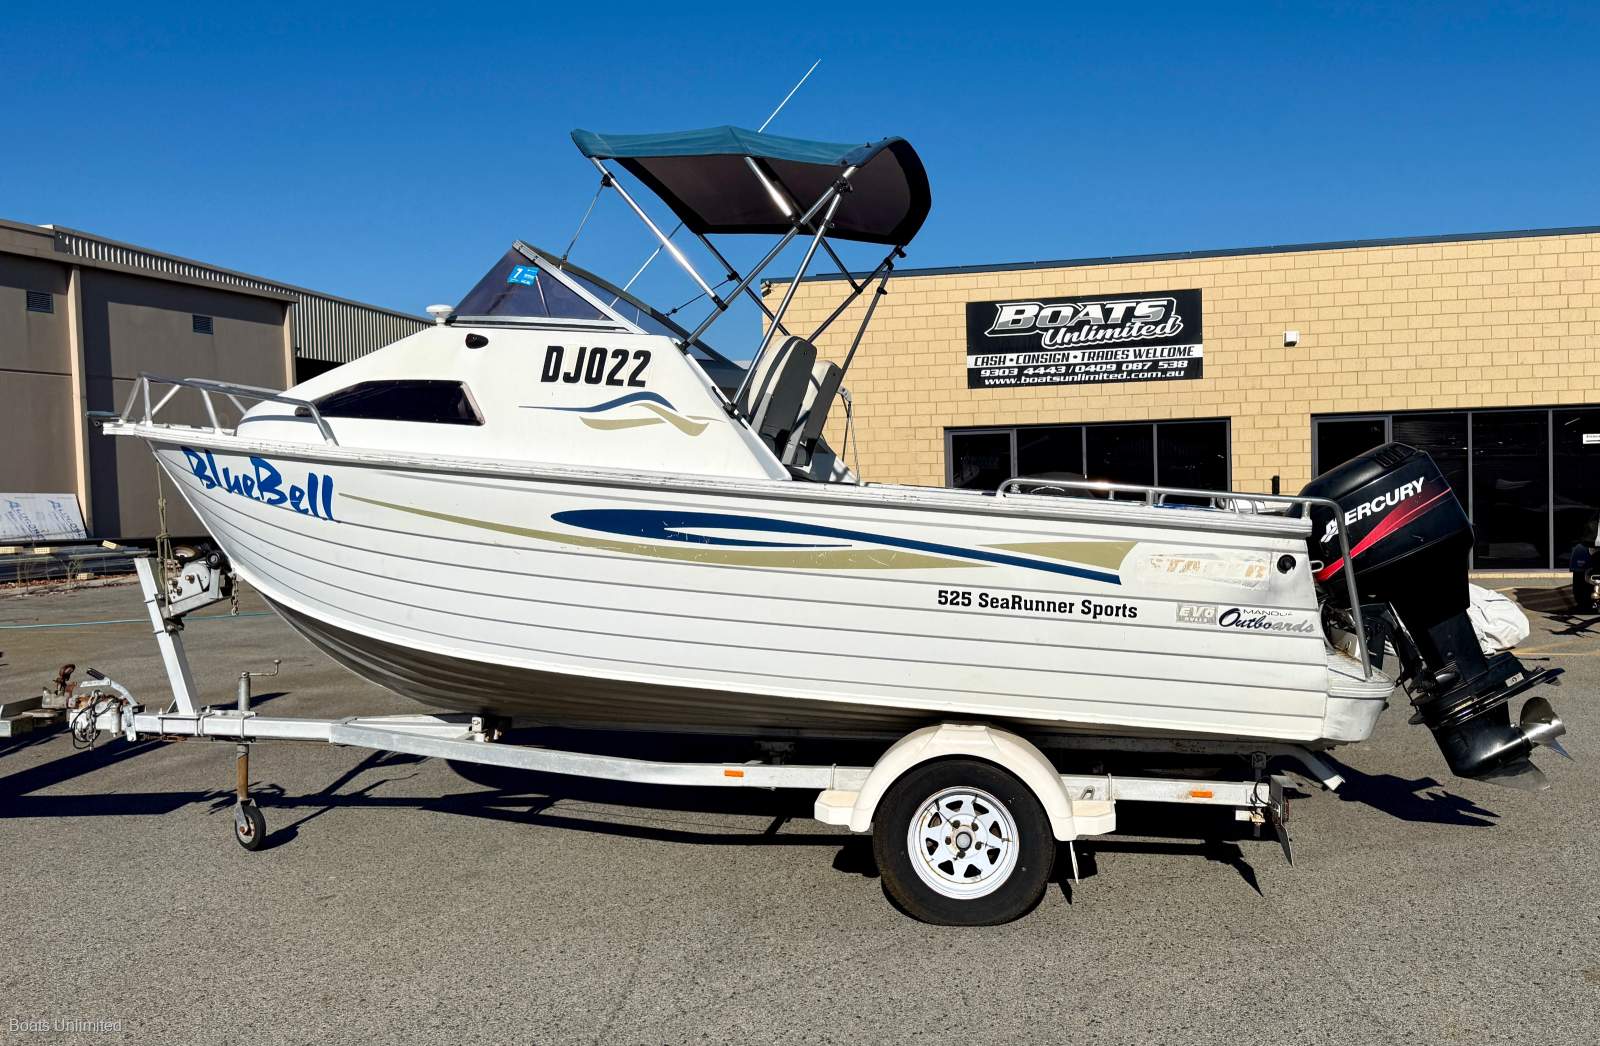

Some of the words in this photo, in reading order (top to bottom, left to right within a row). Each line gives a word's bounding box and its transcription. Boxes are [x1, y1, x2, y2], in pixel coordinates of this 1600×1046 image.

[993, 300, 1169, 331] BOATS
[1044, 316, 1179, 346] Unlimited
[973, 356, 1007, 367] CASH
[1015, 354, 1071, 366] CONSIGN
[1080, 349, 1130, 362] TRADES
[1133, 346, 1195, 359] WELCOME
[980, 368, 1019, 378] 9303
[1121, 361, 1152, 371] 087
[1158, 360, 1189, 369] 538
[984, 369, 1186, 386] www.boatsunlimited.com.au
[180, 445, 335, 521] BlueBell
[937, 589, 972, 607] 525
[978, 592, 1075, 614] SeaRunner
[1080, 599, 1138, 619] Sports
[1218, 607, 1315, 633] Outboards
